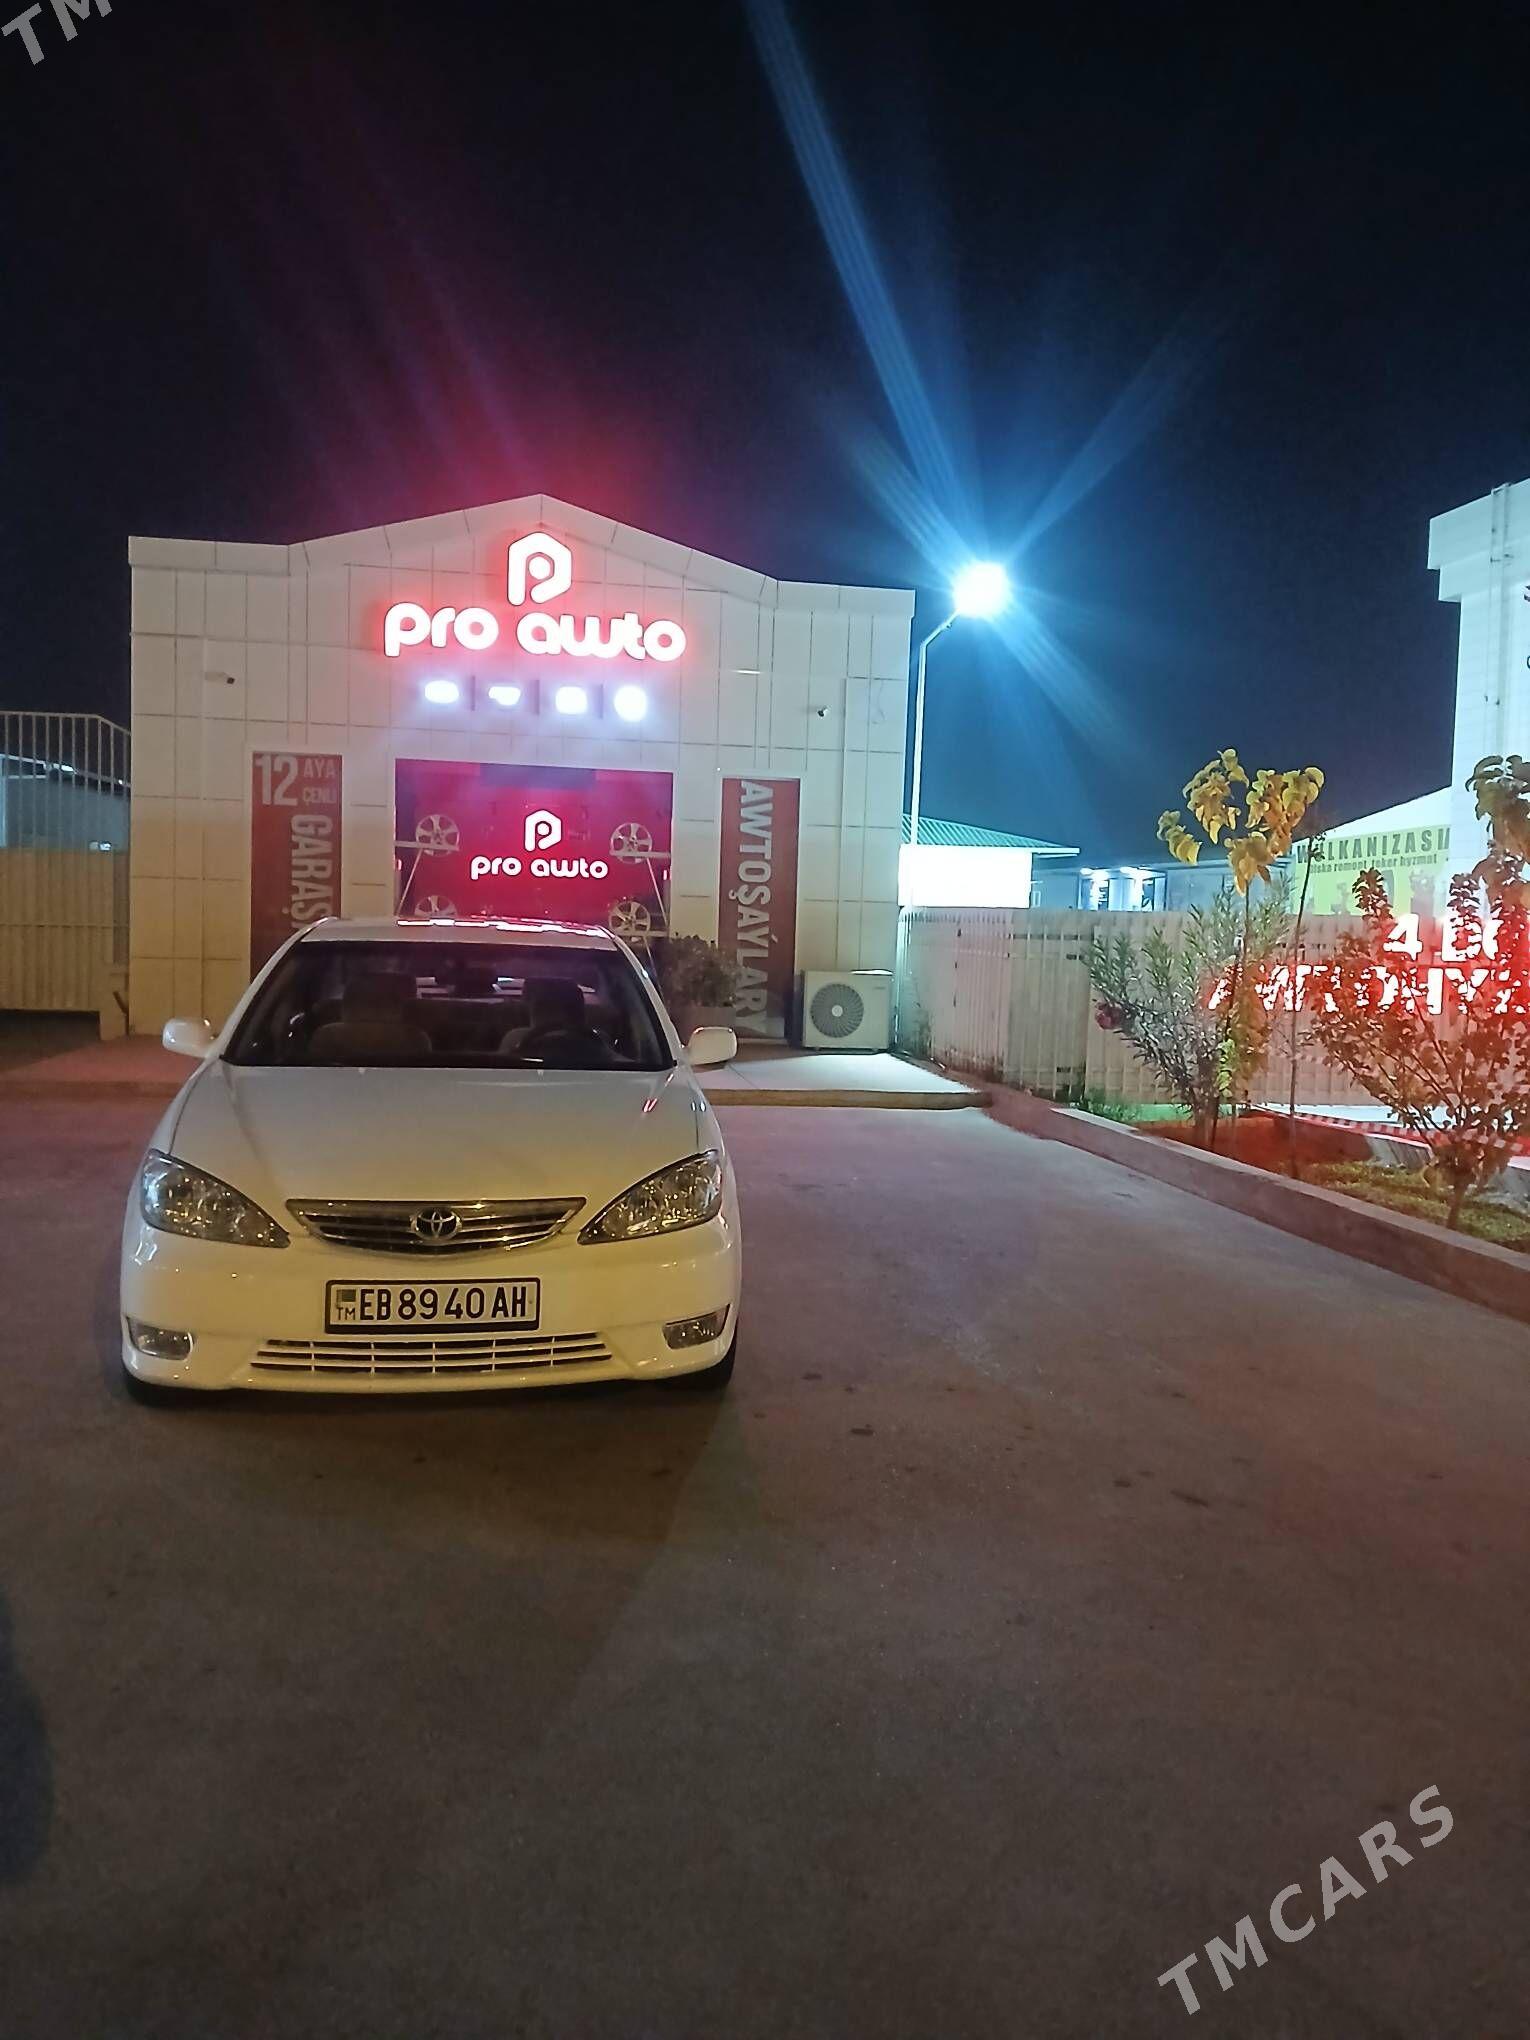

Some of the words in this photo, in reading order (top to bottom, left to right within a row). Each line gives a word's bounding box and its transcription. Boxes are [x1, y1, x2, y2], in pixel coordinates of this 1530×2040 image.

[384, 602, 499, 657] pro
[516, 612, 686, 661] awto
[255, 755, 298, 806] 12
[282, 814, 333, 929] GARAŞ
[471, 856, 522, 880] pro
[530, 857, 608, 879] awto
[336, 1306, 356, 1321] TM
[360, 1288, 391, 1321] EB
[399, 1288, 438, 1320] 89
[444, 1287, 484, 1319] 40
[491, 1286, 526, 1318] AH
